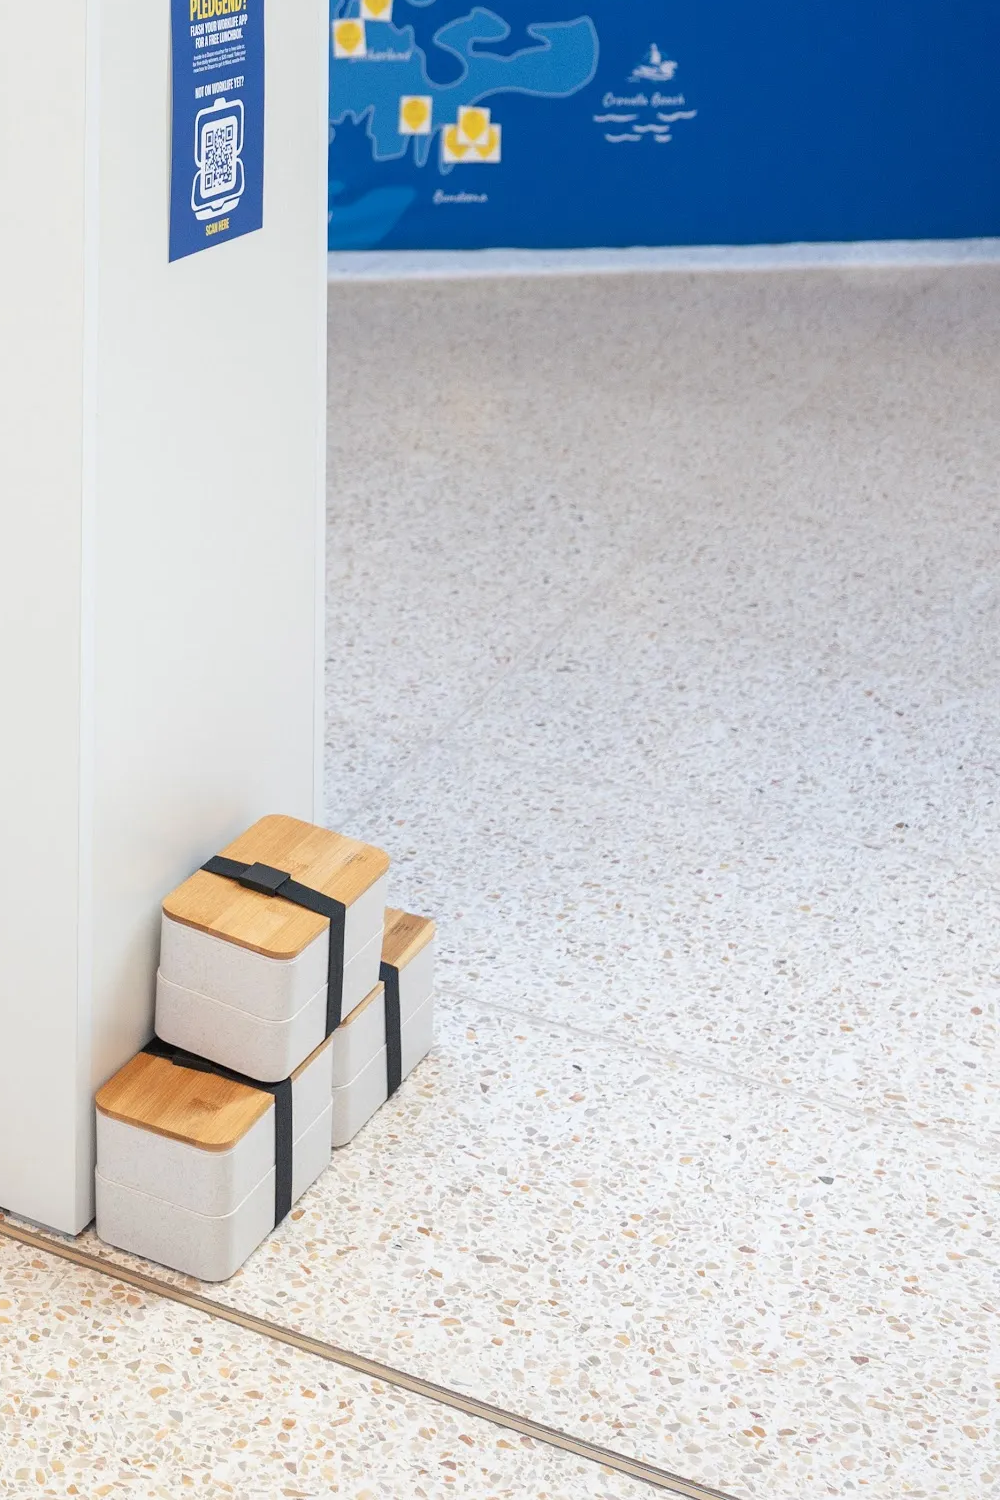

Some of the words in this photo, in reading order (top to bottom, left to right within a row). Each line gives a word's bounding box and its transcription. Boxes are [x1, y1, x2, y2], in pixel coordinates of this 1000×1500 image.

[190, 23, 204, 37] FLASH
[205, 21, 217, 33] YOUR
[239, 14, 248, 26] APP
[195, 36, 204, 49] FOR
[205, 36, 208, 46] A
[209, 33, 219, 46] FREE
[205, 84, 211, 96] ON
[234, 75, 244, 89] YET?
[650, 91, 685, 107] Beach
[206, 222, 218, 236] SCAN
[219, 218, 229, 231] HERE
